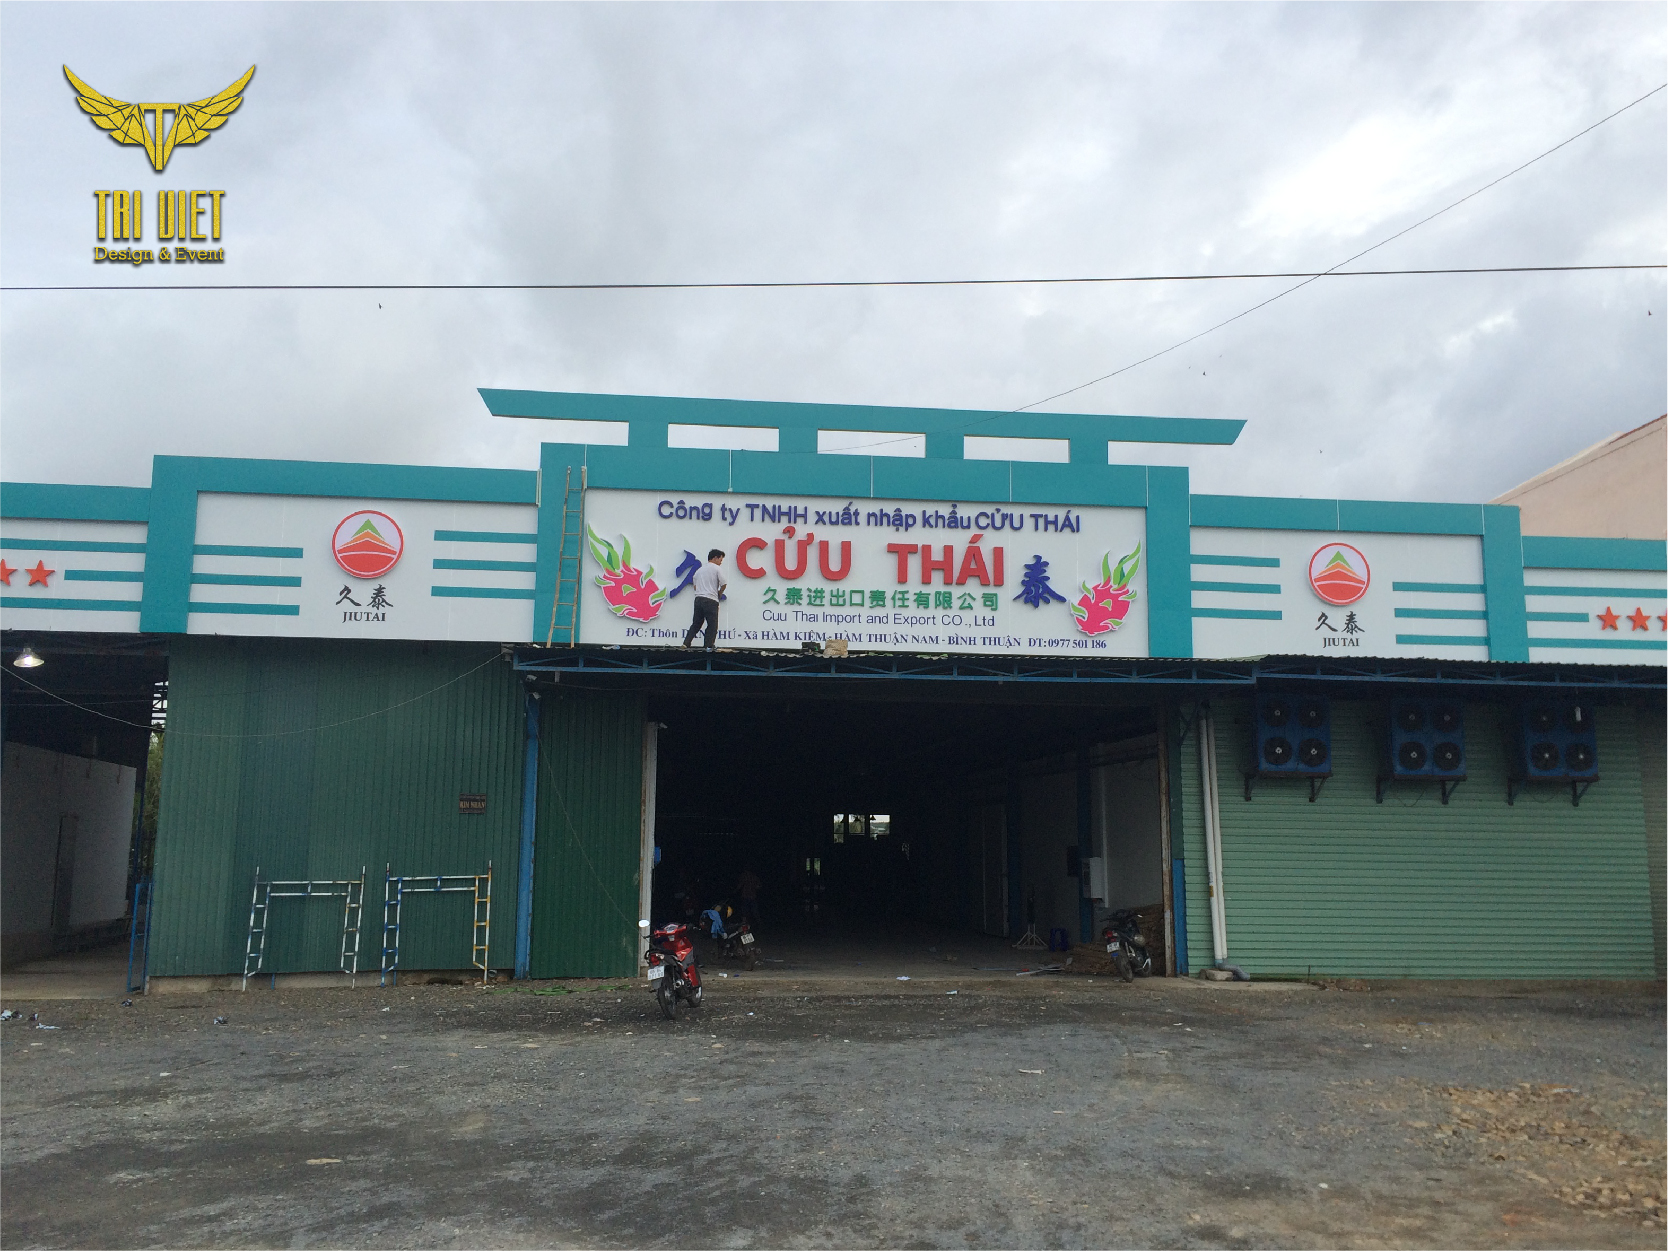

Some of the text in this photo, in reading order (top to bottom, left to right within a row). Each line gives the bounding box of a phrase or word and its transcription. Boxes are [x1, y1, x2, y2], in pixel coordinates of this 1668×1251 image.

[658, 500, 1081, 533] Công ty TNHH xuất nhập khẩu CỬU THÁI
[736, 525, 1004, 586] CỬU THÁI
[1012, 554, 1067, 609] 泰
[335, 584, 394, 610] 久泰
[762, 586, 999, 611] 久泰进出口责任有限公司
[342, 611, 386, 623] JIUTAI
[762, 609, 788, 621] Cuu
[822, 611, 861, 625] Import
[866, 613, 889, 625] and
[893, 614, 936, 628] Export
[1315, 611, 1365, 635] 久泰
[650, 627, 678, 638] Thôn
[744, 629, 758, 640] Xã
[761, 629, 790, 641] HÀM
[834, 630, 863, 642] HÀM
[866, 632, 908, 645] THUẬN
[911, 634, 939, 645] NAM
[948, 633, 977, 646] BÌNH
[980, 634, 1021, 648] THUẬN
[1323, 637, 1360, 648] JIUTAI
